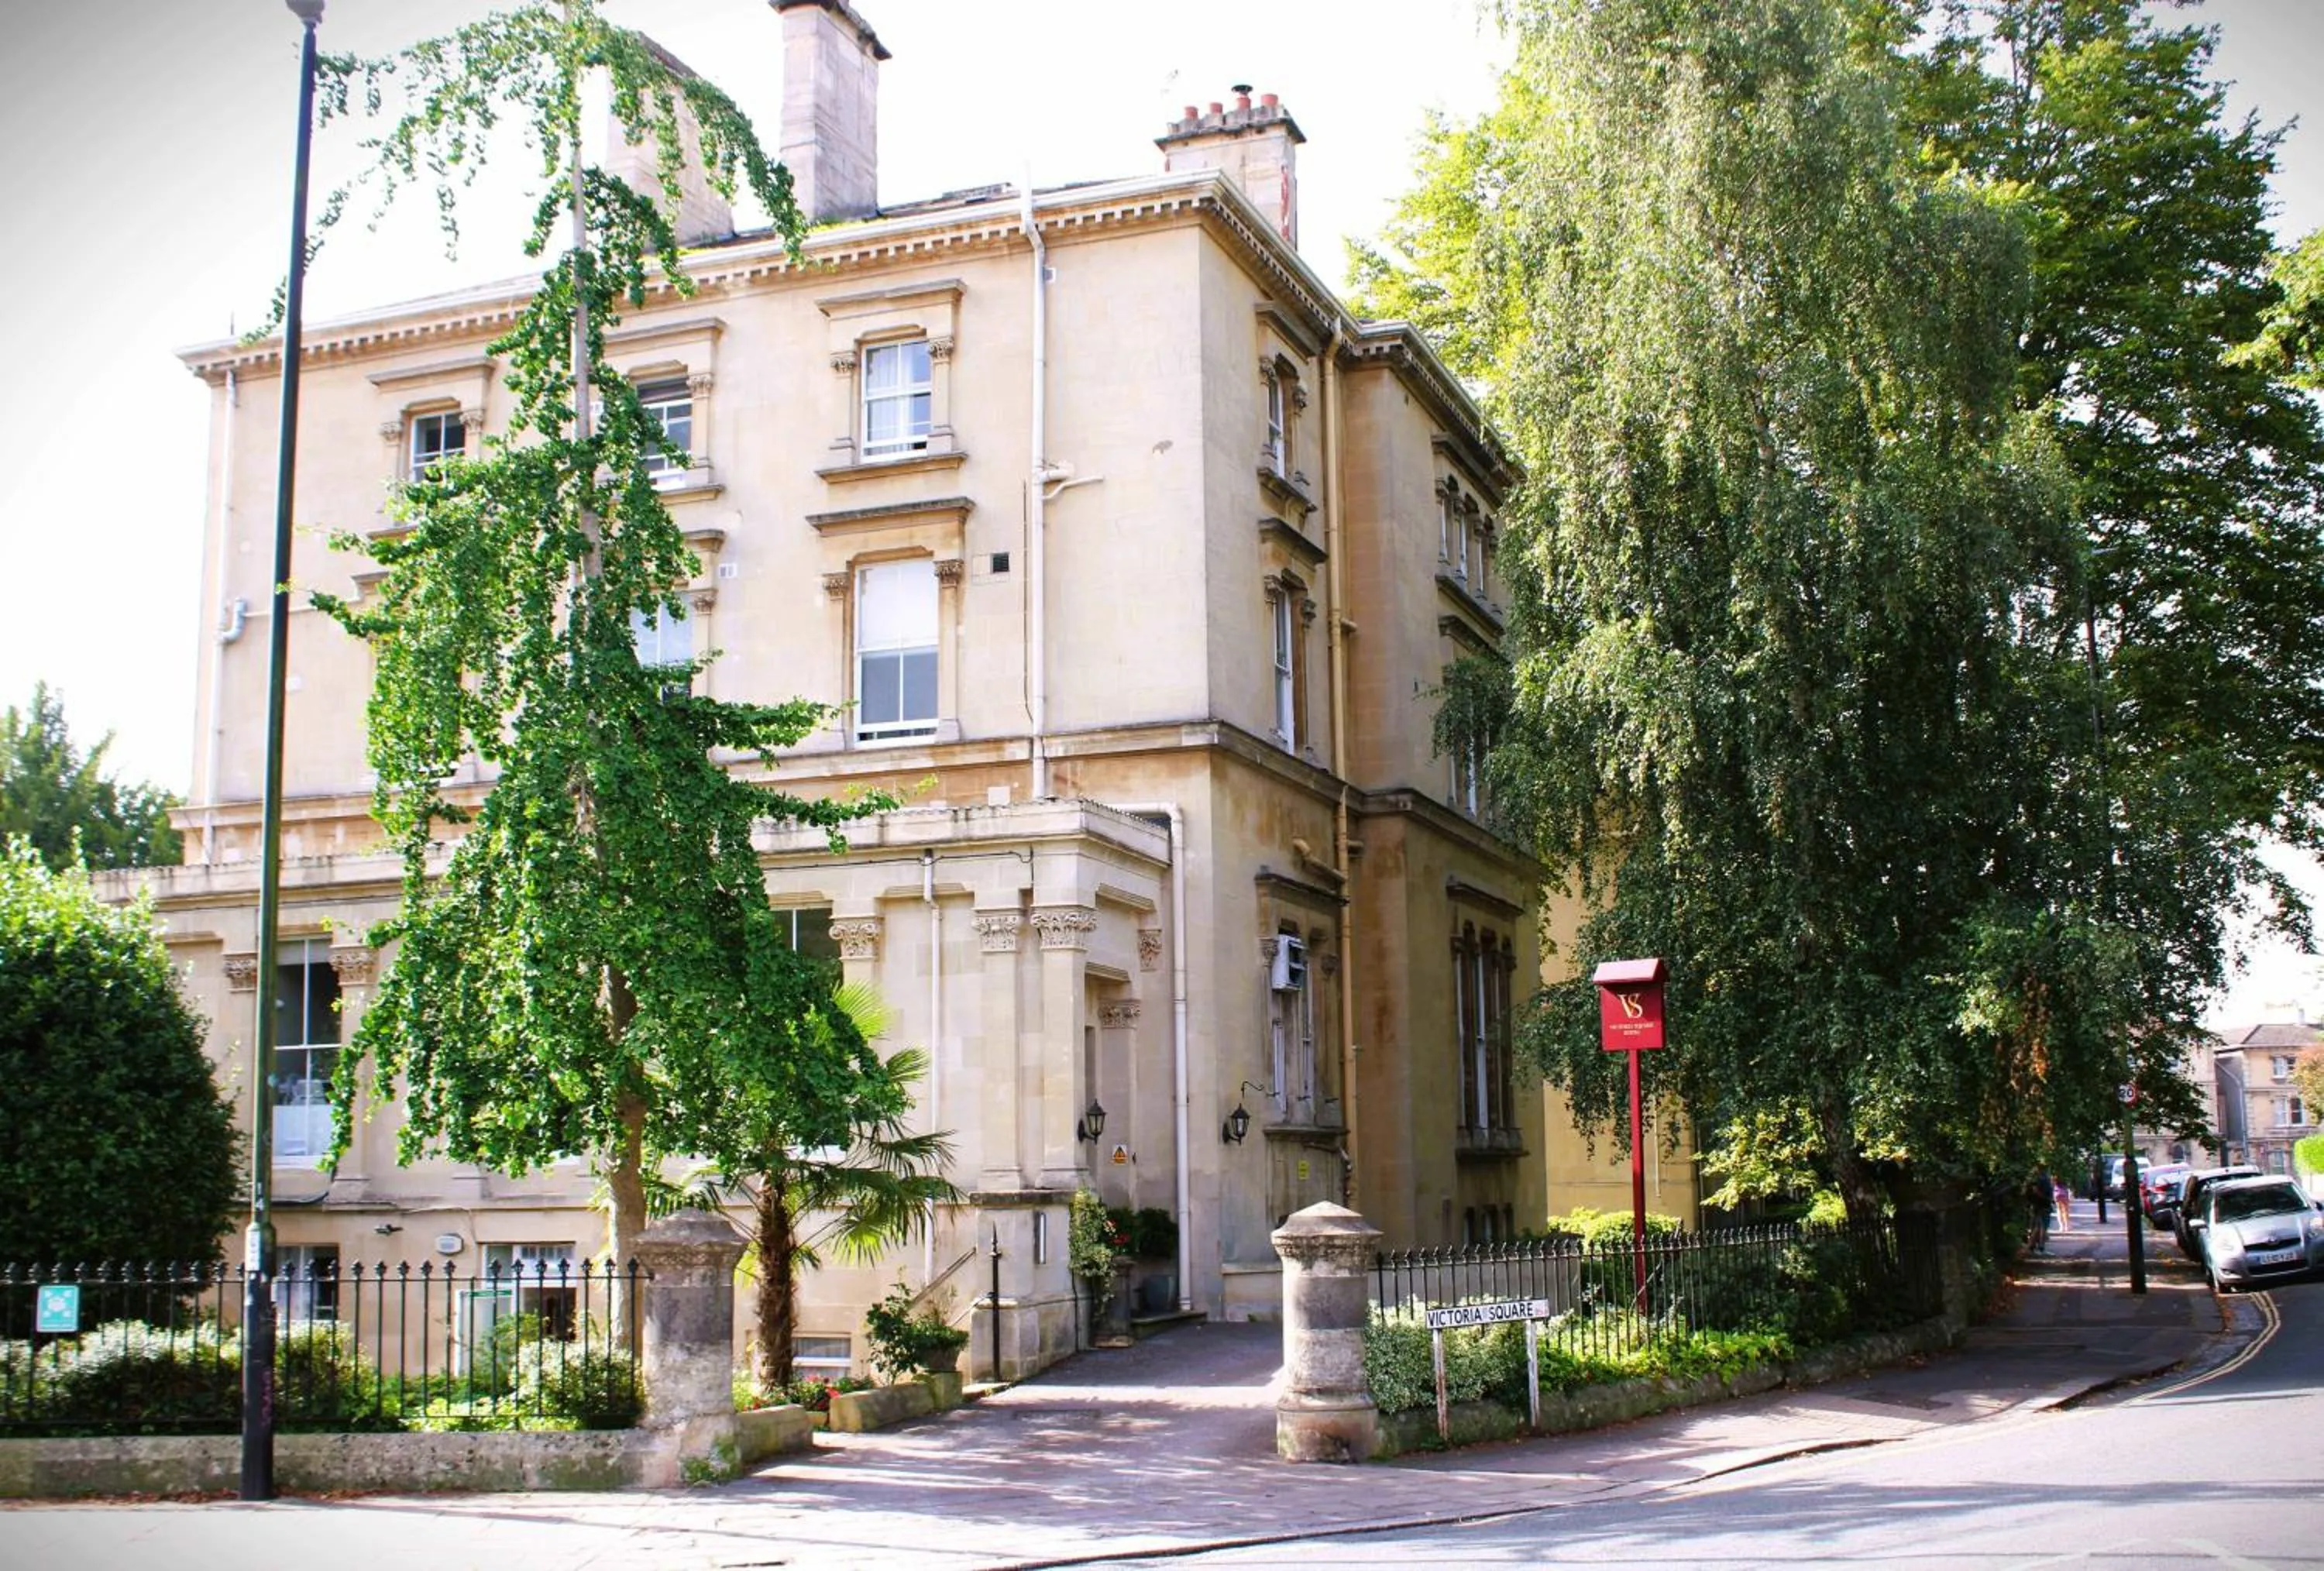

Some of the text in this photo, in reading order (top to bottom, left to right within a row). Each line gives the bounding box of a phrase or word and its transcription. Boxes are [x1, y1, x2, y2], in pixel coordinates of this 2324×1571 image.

[1618, 993, 1643, 1019] VS
[2119, 1088, 2133, 1098] 20
[1428, 1308, 1482, 1326] VICTORIA
[1488, 1302, 1534, 1320] SQUARE
